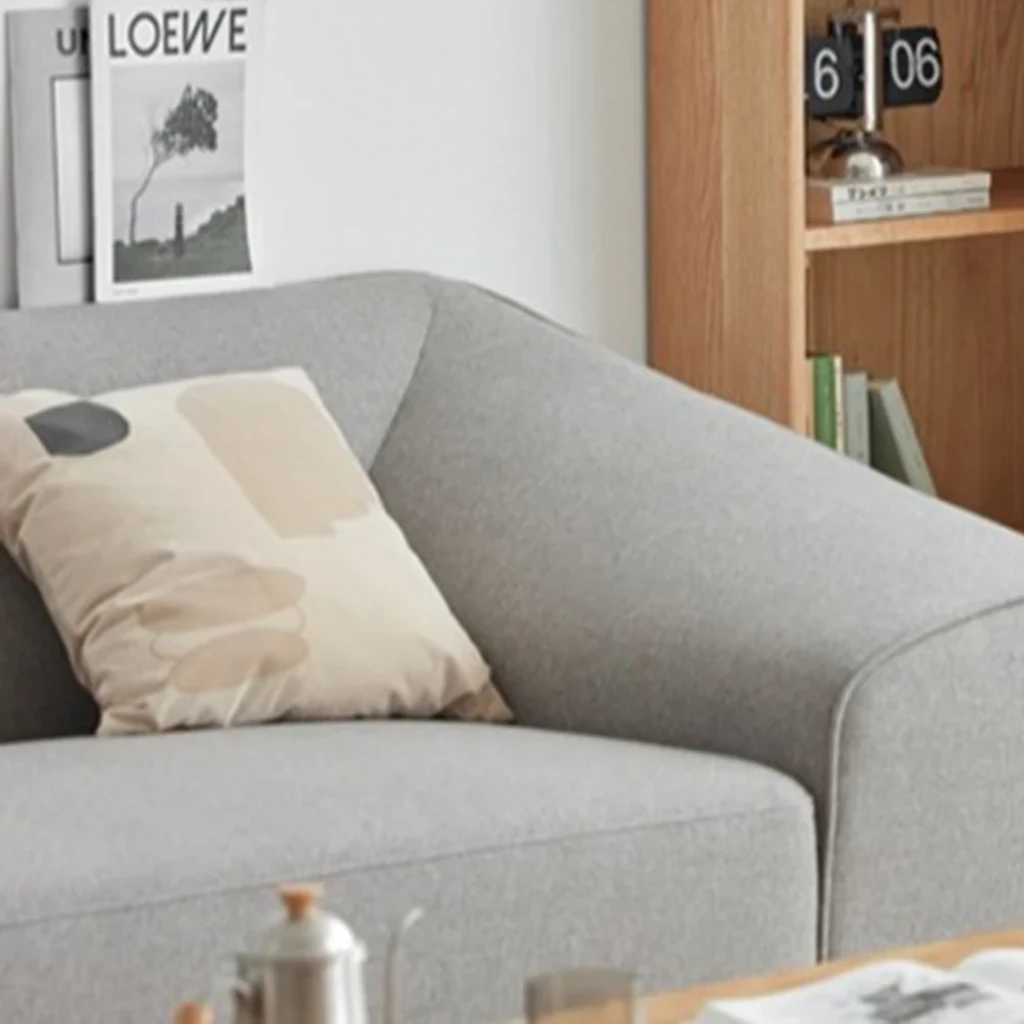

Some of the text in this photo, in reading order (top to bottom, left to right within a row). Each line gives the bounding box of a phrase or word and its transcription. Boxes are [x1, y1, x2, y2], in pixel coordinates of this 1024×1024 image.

[108, 8, 248, 57] LOEWE
[814, 47, 840, 100] 6
[890, 37, 941, 89] 06
